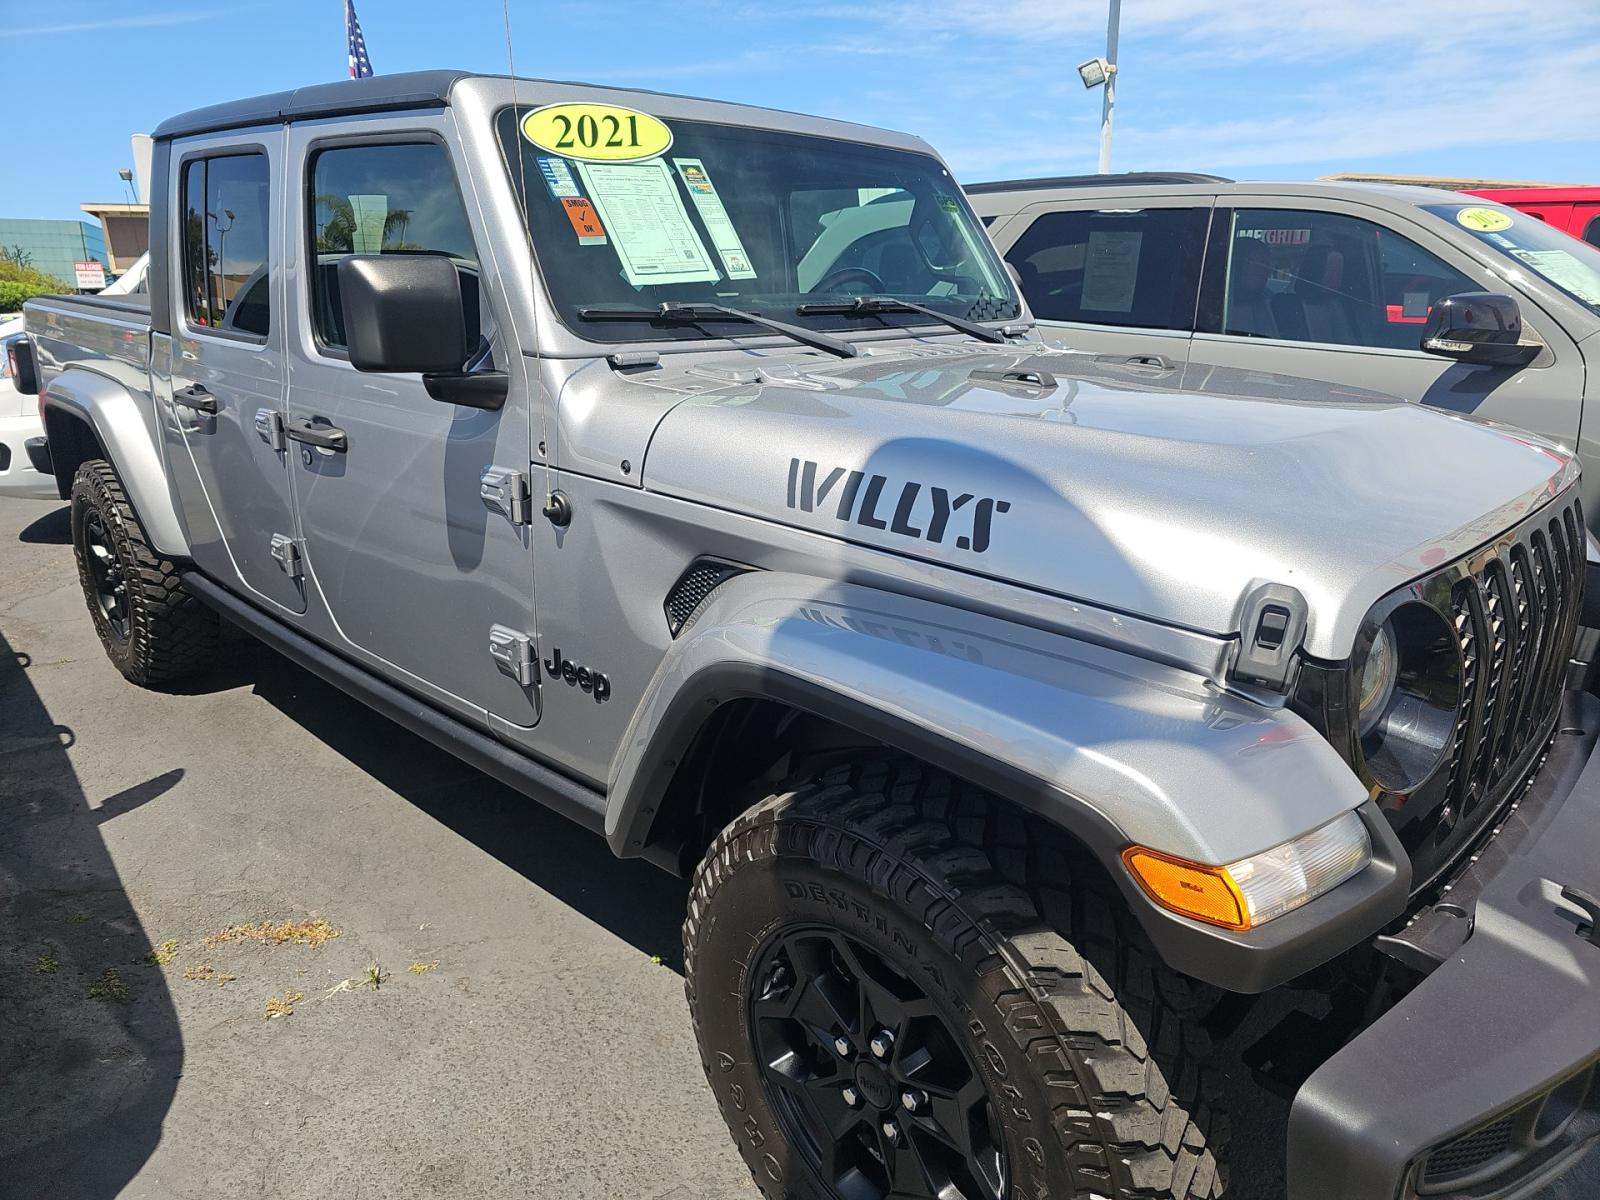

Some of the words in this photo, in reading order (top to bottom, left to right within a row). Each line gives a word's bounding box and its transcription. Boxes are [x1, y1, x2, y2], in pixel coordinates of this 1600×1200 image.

[552, 114, 643, 149] 2021
[566, 199, 591, 208] SMOG
[583, 224, 596, 233] OK
[787, 457, 1011, 553] WILLYS
[543, 647, 611, 705] Jeep
